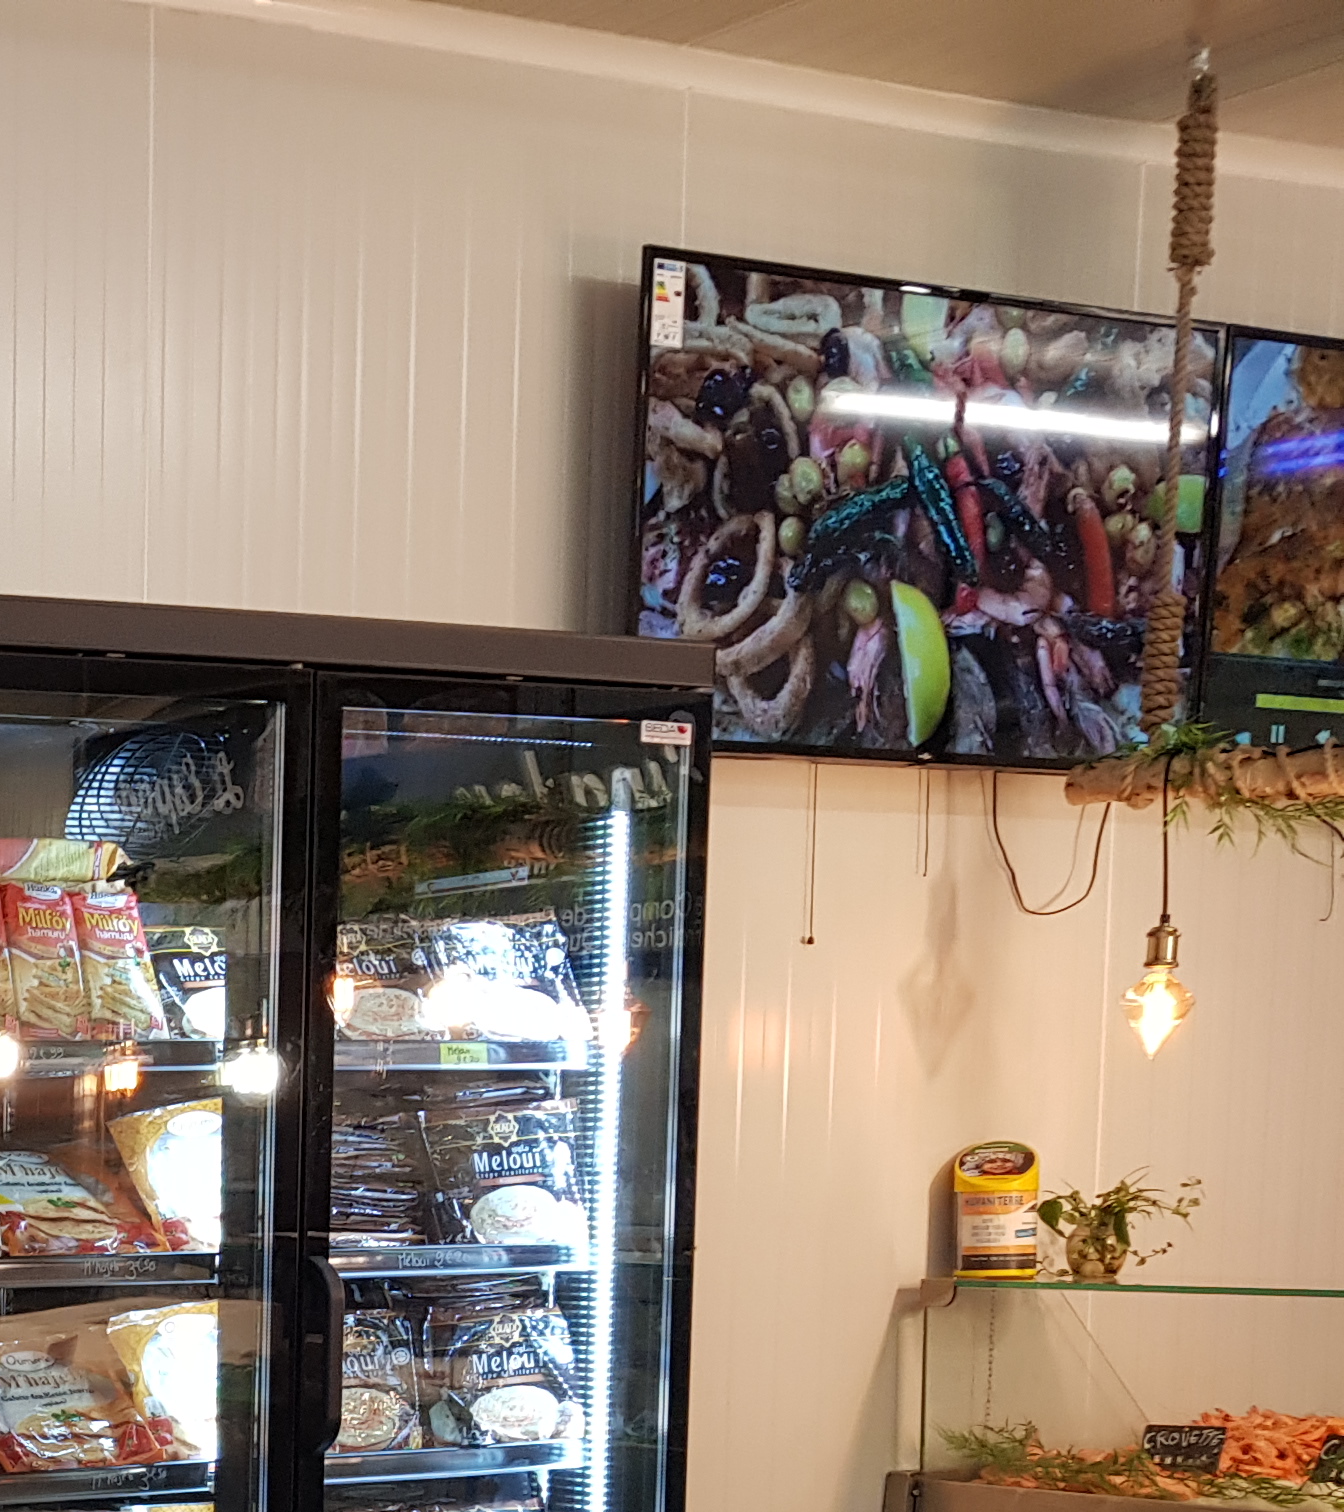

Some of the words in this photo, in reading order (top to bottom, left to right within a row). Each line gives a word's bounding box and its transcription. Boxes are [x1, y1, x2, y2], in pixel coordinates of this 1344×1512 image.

[18, 907, 72, 933] Milföy
[84, 911, 140, 936] Milföy
[472, 1150, 542, 1174] Melouï
